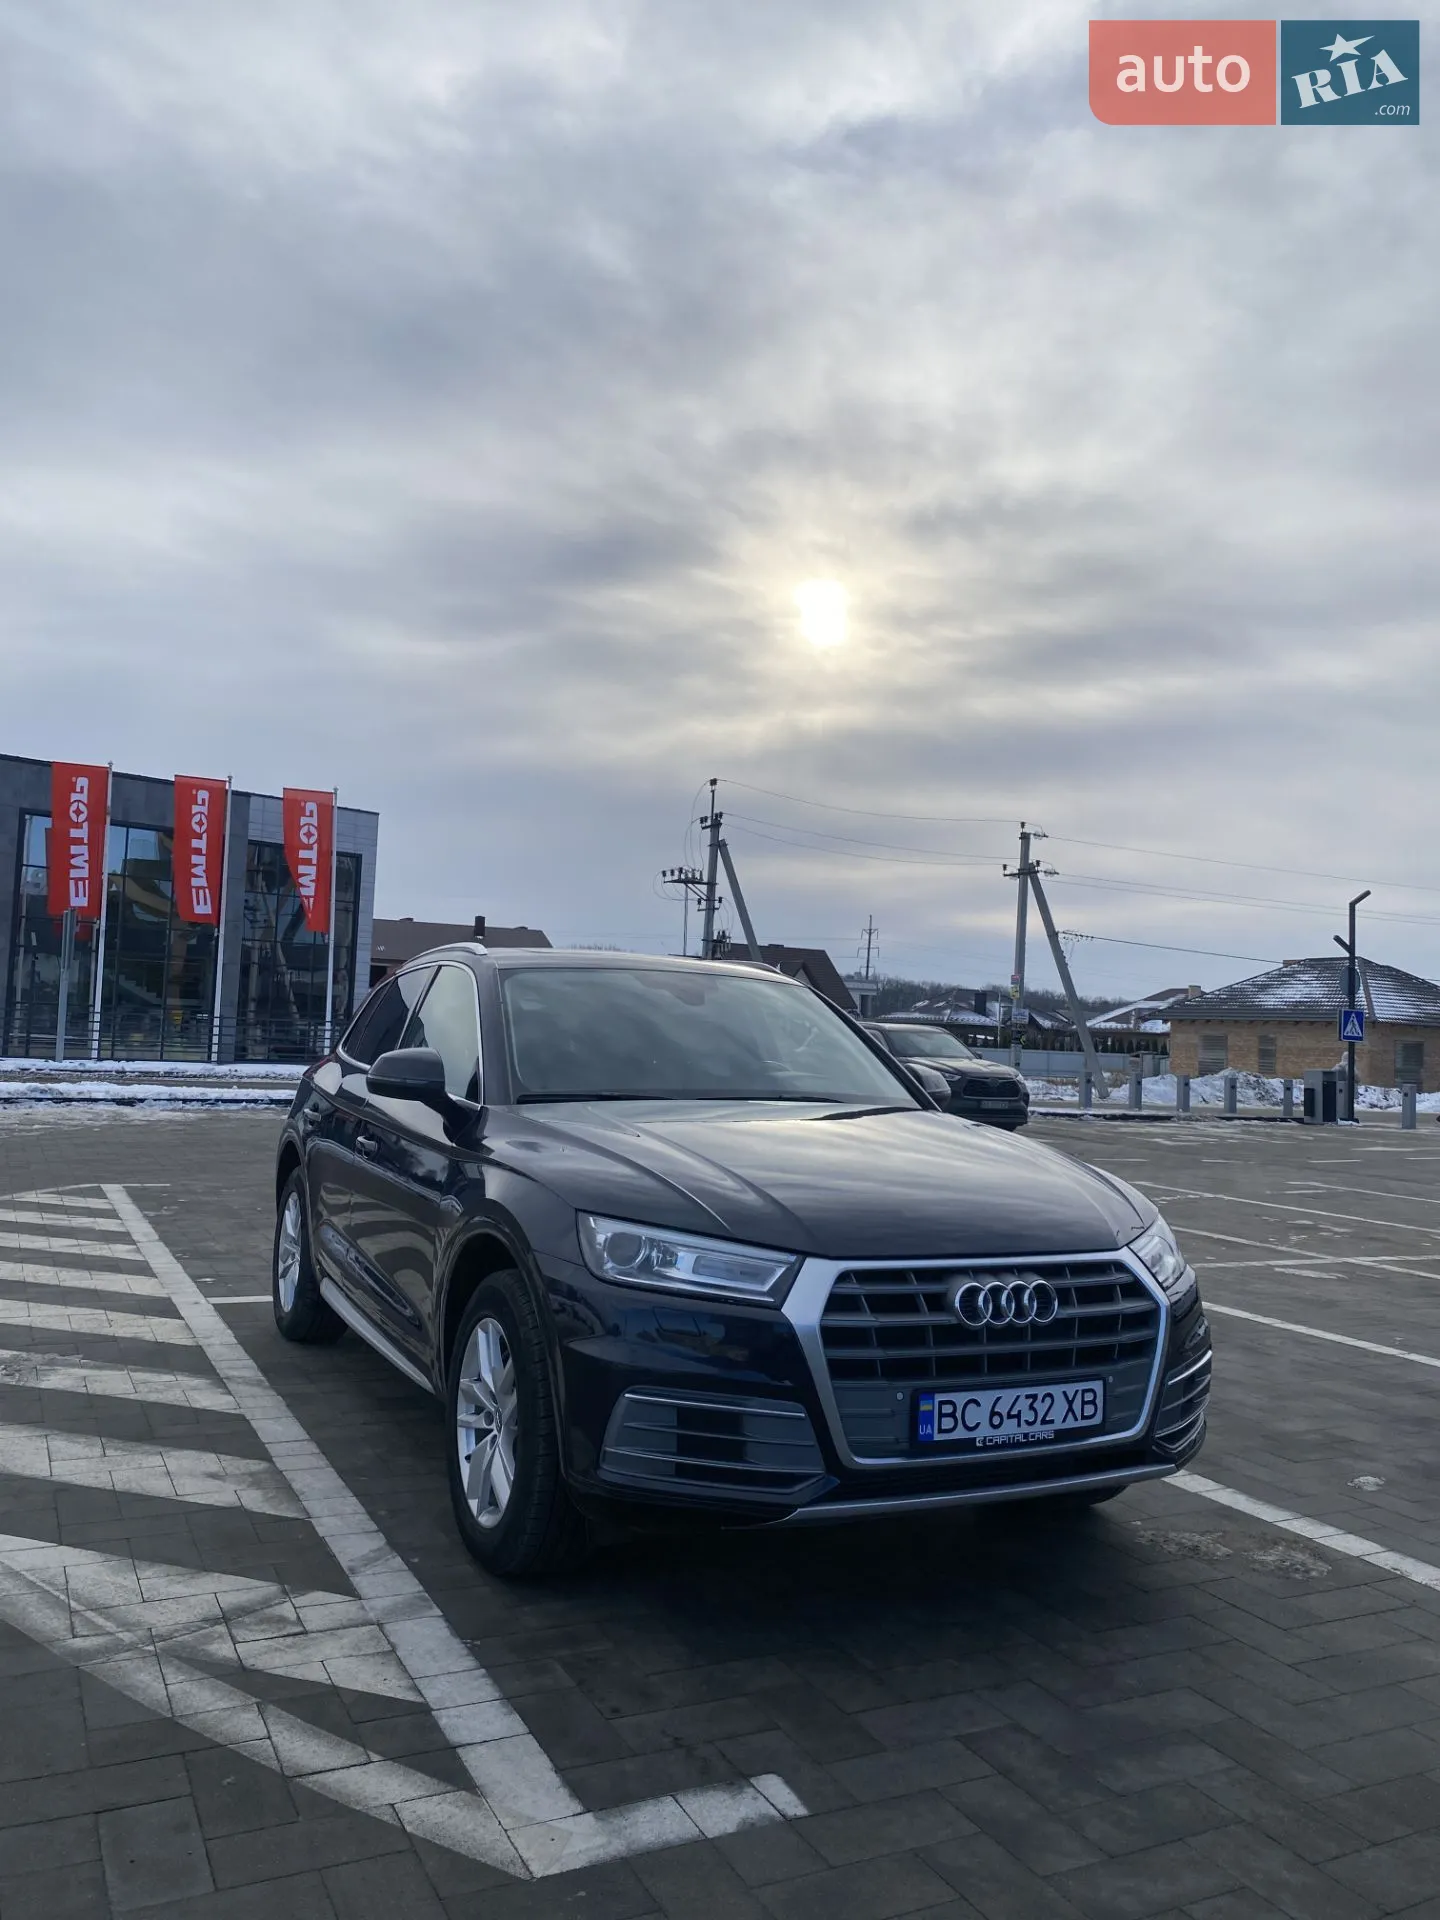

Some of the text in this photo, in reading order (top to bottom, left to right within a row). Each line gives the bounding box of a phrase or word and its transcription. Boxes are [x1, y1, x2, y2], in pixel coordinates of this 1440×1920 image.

[937, 1388, 1098, 1434] BC 6432 XB
[919, 1424, 932, 1435] UA
[986, 1430, 1055, 1446] CAPITAL CARS
